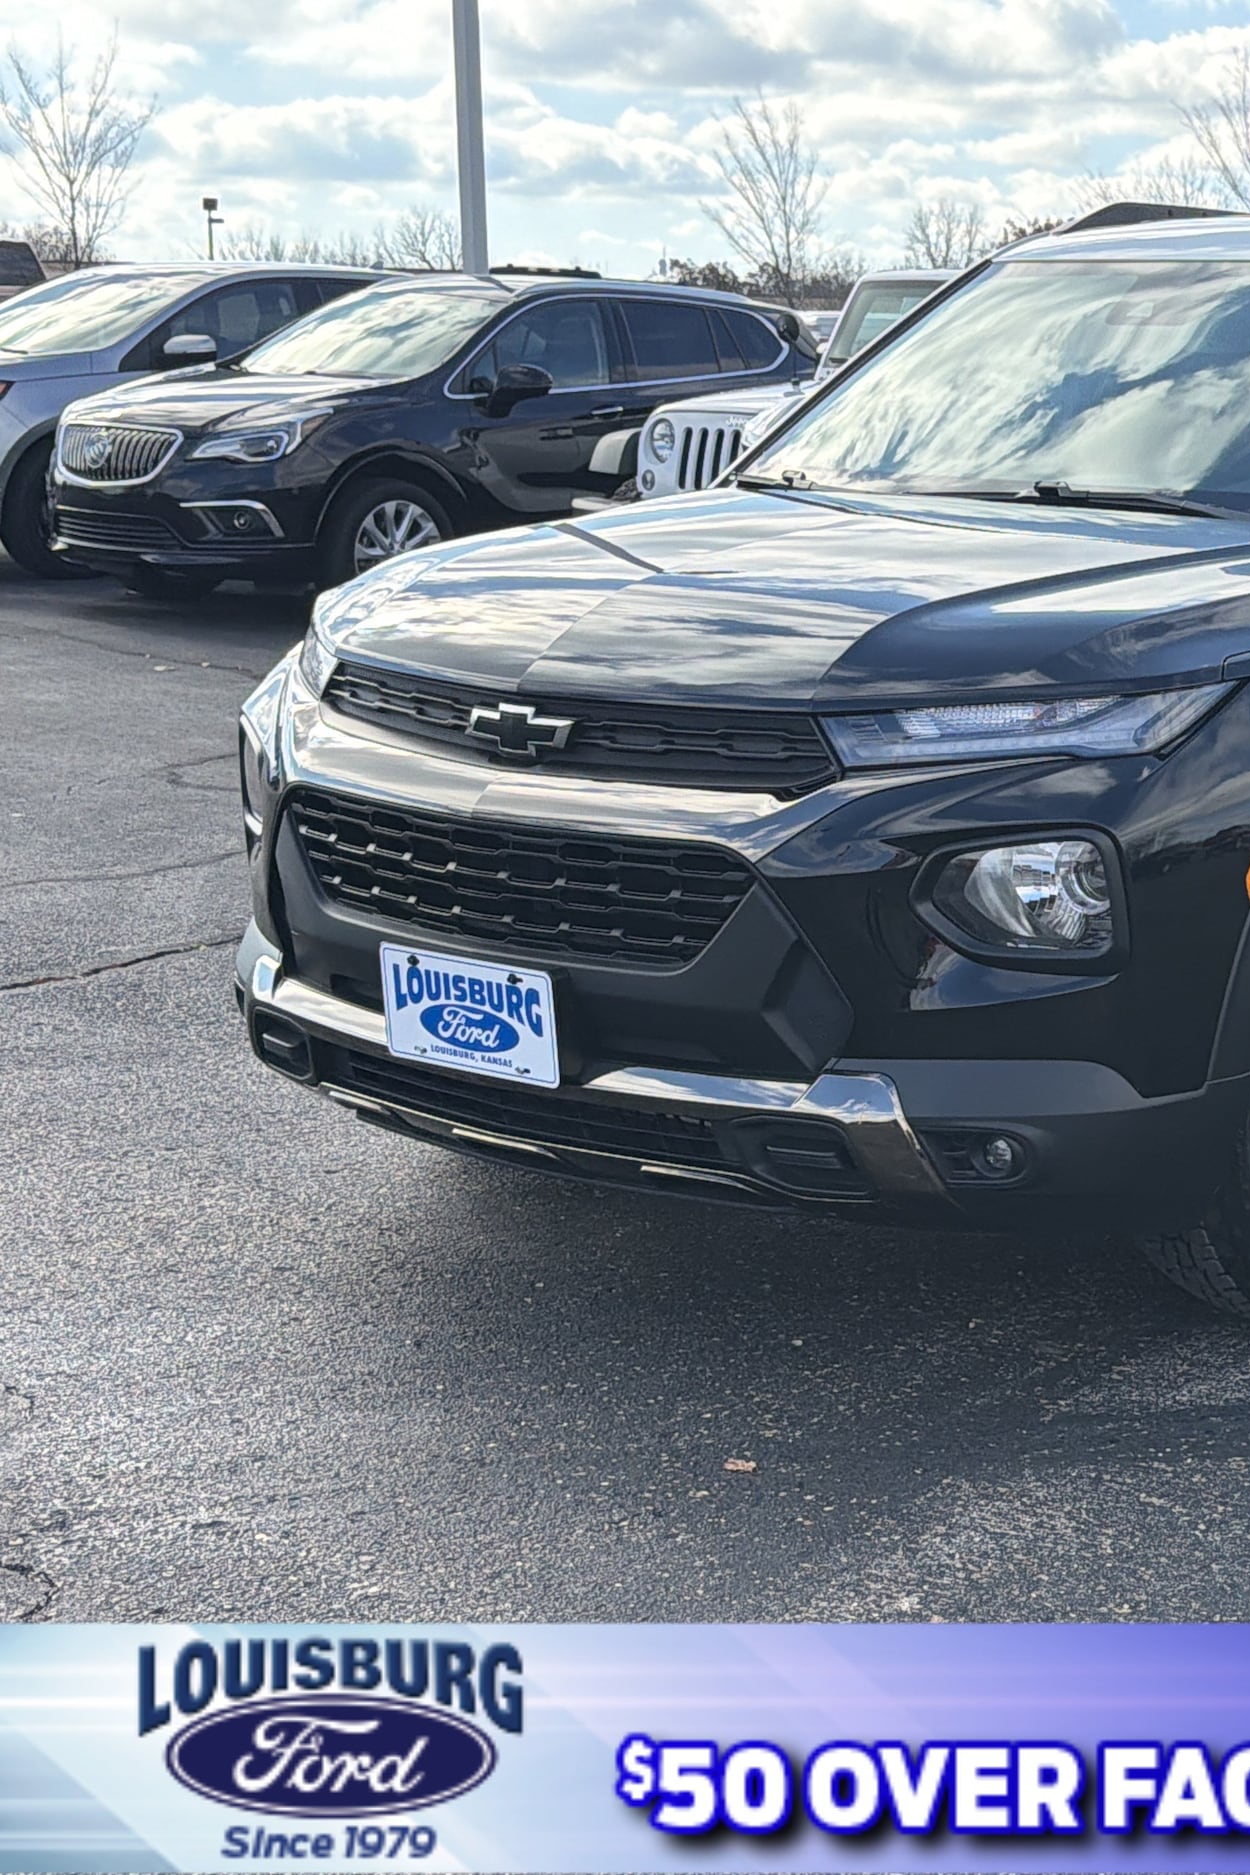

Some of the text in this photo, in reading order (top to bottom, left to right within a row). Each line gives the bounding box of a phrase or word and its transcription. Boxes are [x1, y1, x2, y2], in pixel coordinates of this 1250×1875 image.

[392, 963, 543, 1038] LOUISBURG
[437, 1006, 499, 1048] Ford
[430, 1043, 513, 1068] LOUISBURG, KANSAS
